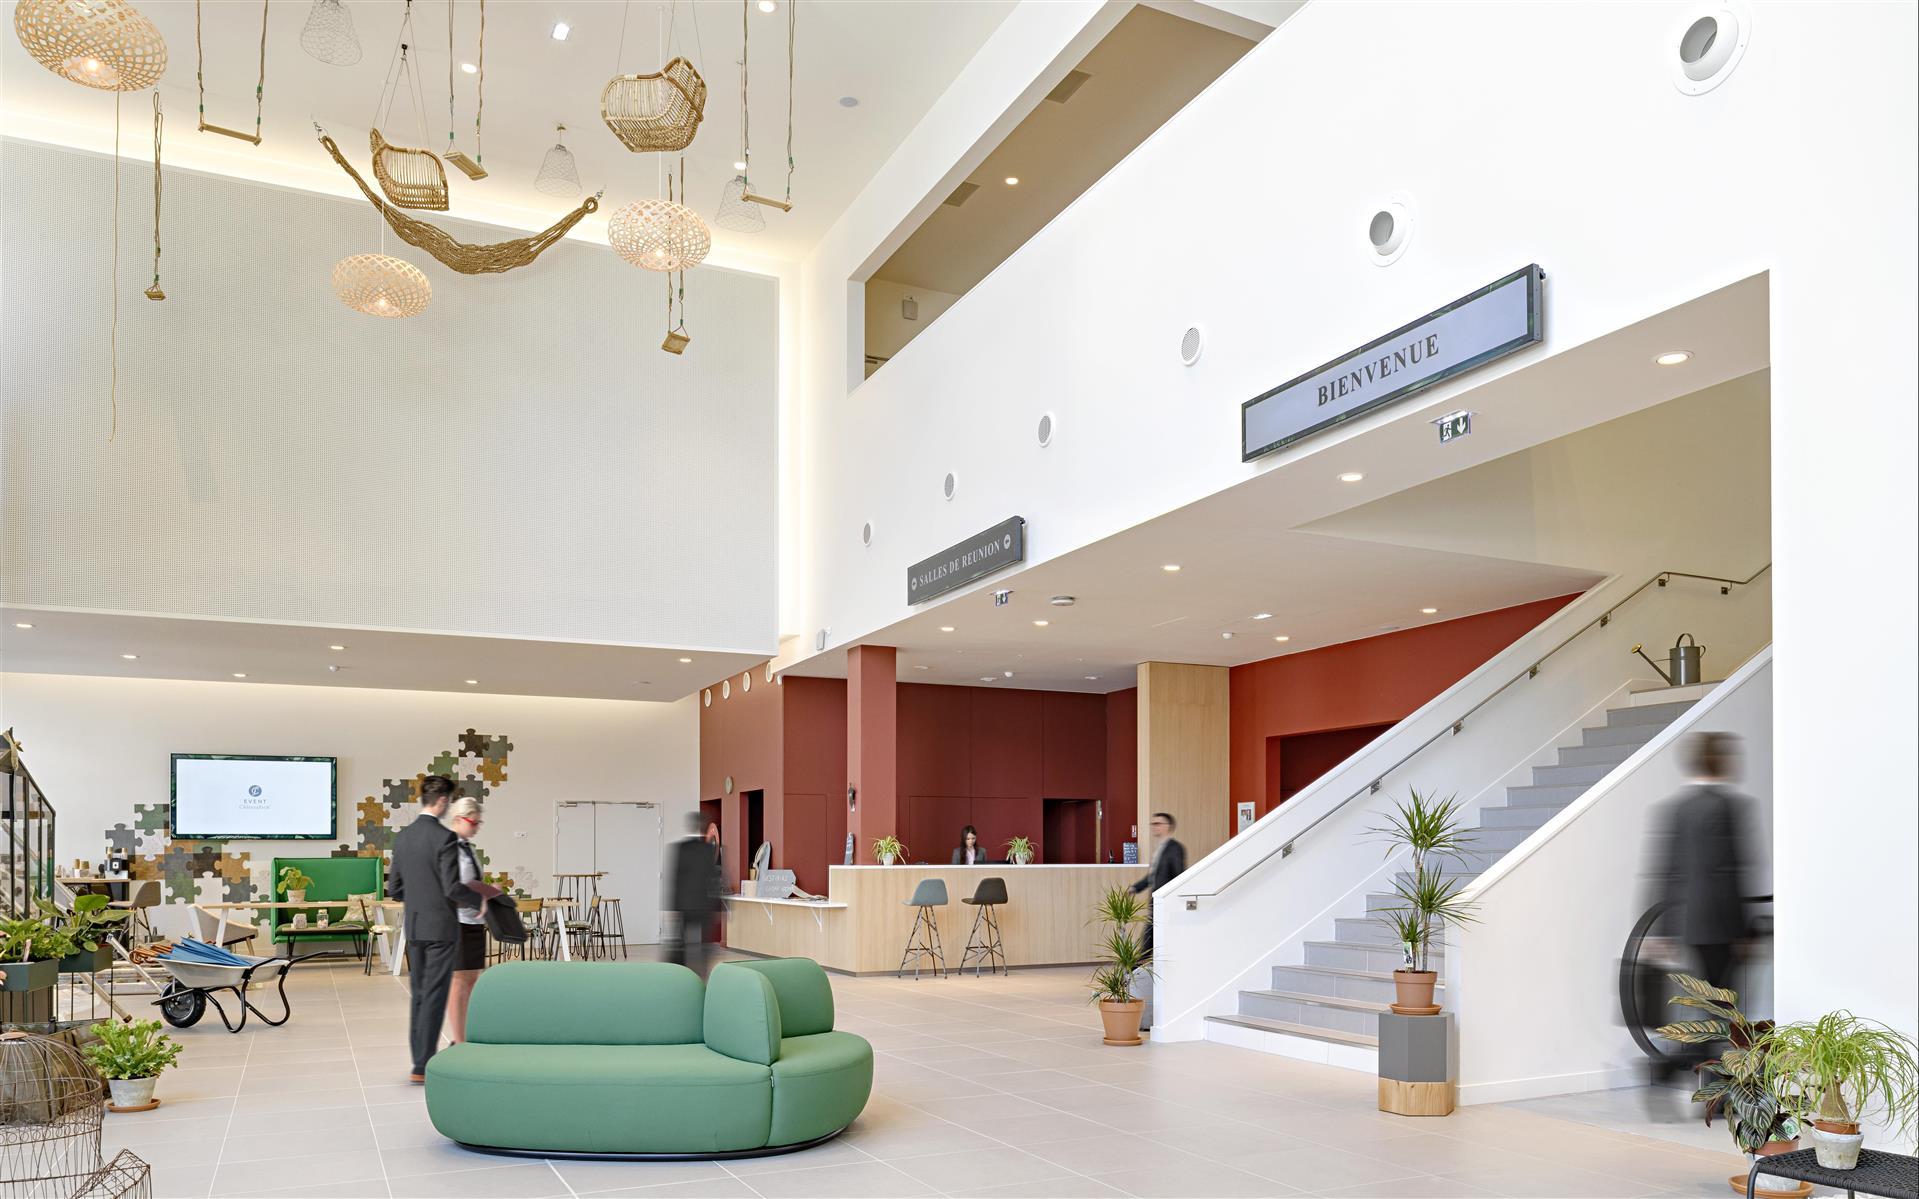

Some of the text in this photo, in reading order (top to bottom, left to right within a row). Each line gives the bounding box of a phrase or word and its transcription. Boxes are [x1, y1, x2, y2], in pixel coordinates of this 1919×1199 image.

[1317, 333, 1439, 407] BIENVENUE
[919, 563, 947, 587] SALLES
[949, 557, 960, 574] DE
